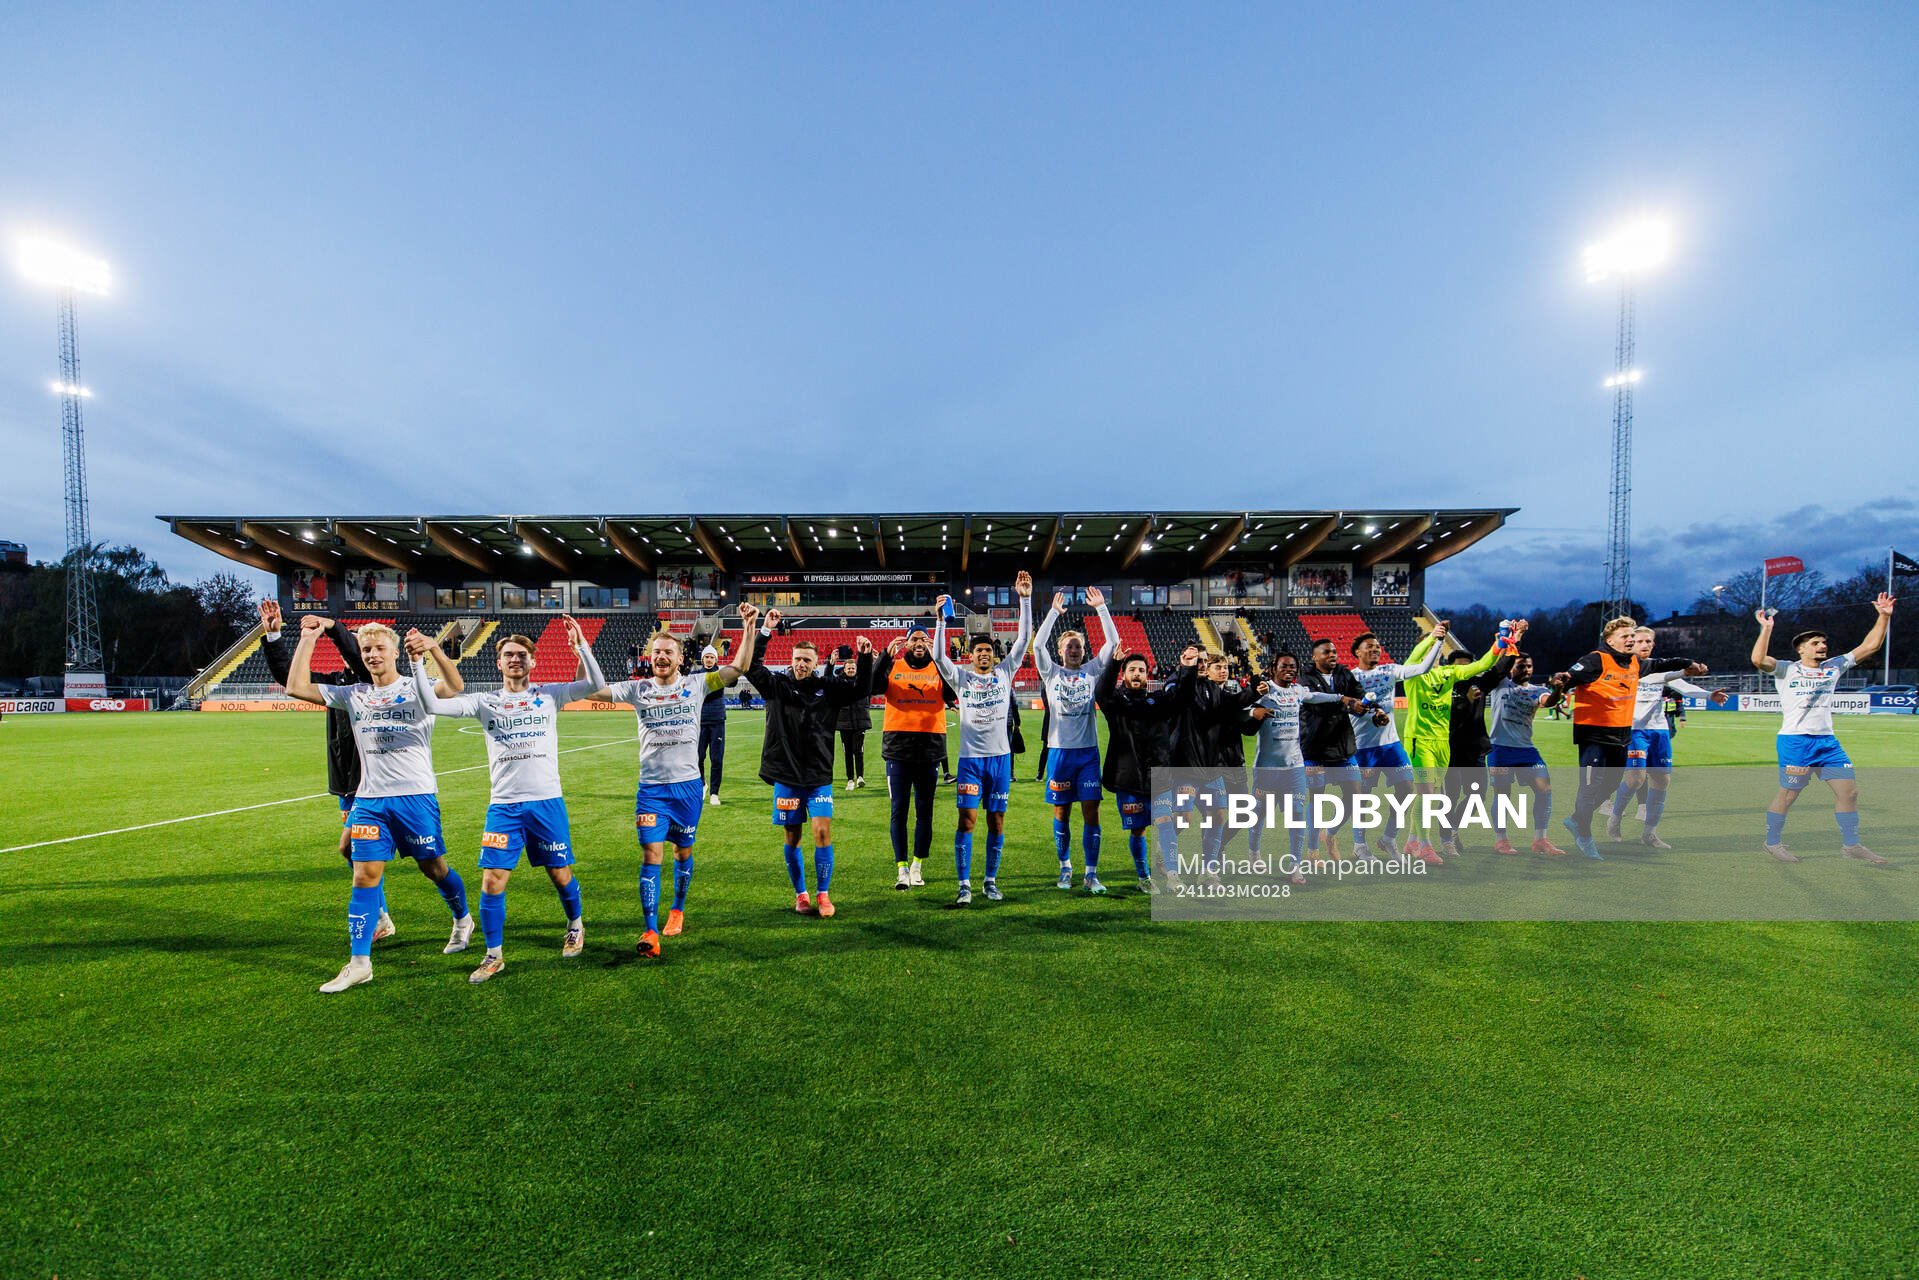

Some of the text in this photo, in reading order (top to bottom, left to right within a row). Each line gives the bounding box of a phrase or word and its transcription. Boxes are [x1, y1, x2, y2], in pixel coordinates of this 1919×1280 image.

[870, 618, 915, 628] stadium
[1753, 697, 1782, 708] Therm
[494, 730, 546, 742] ZINKTEKNIK
